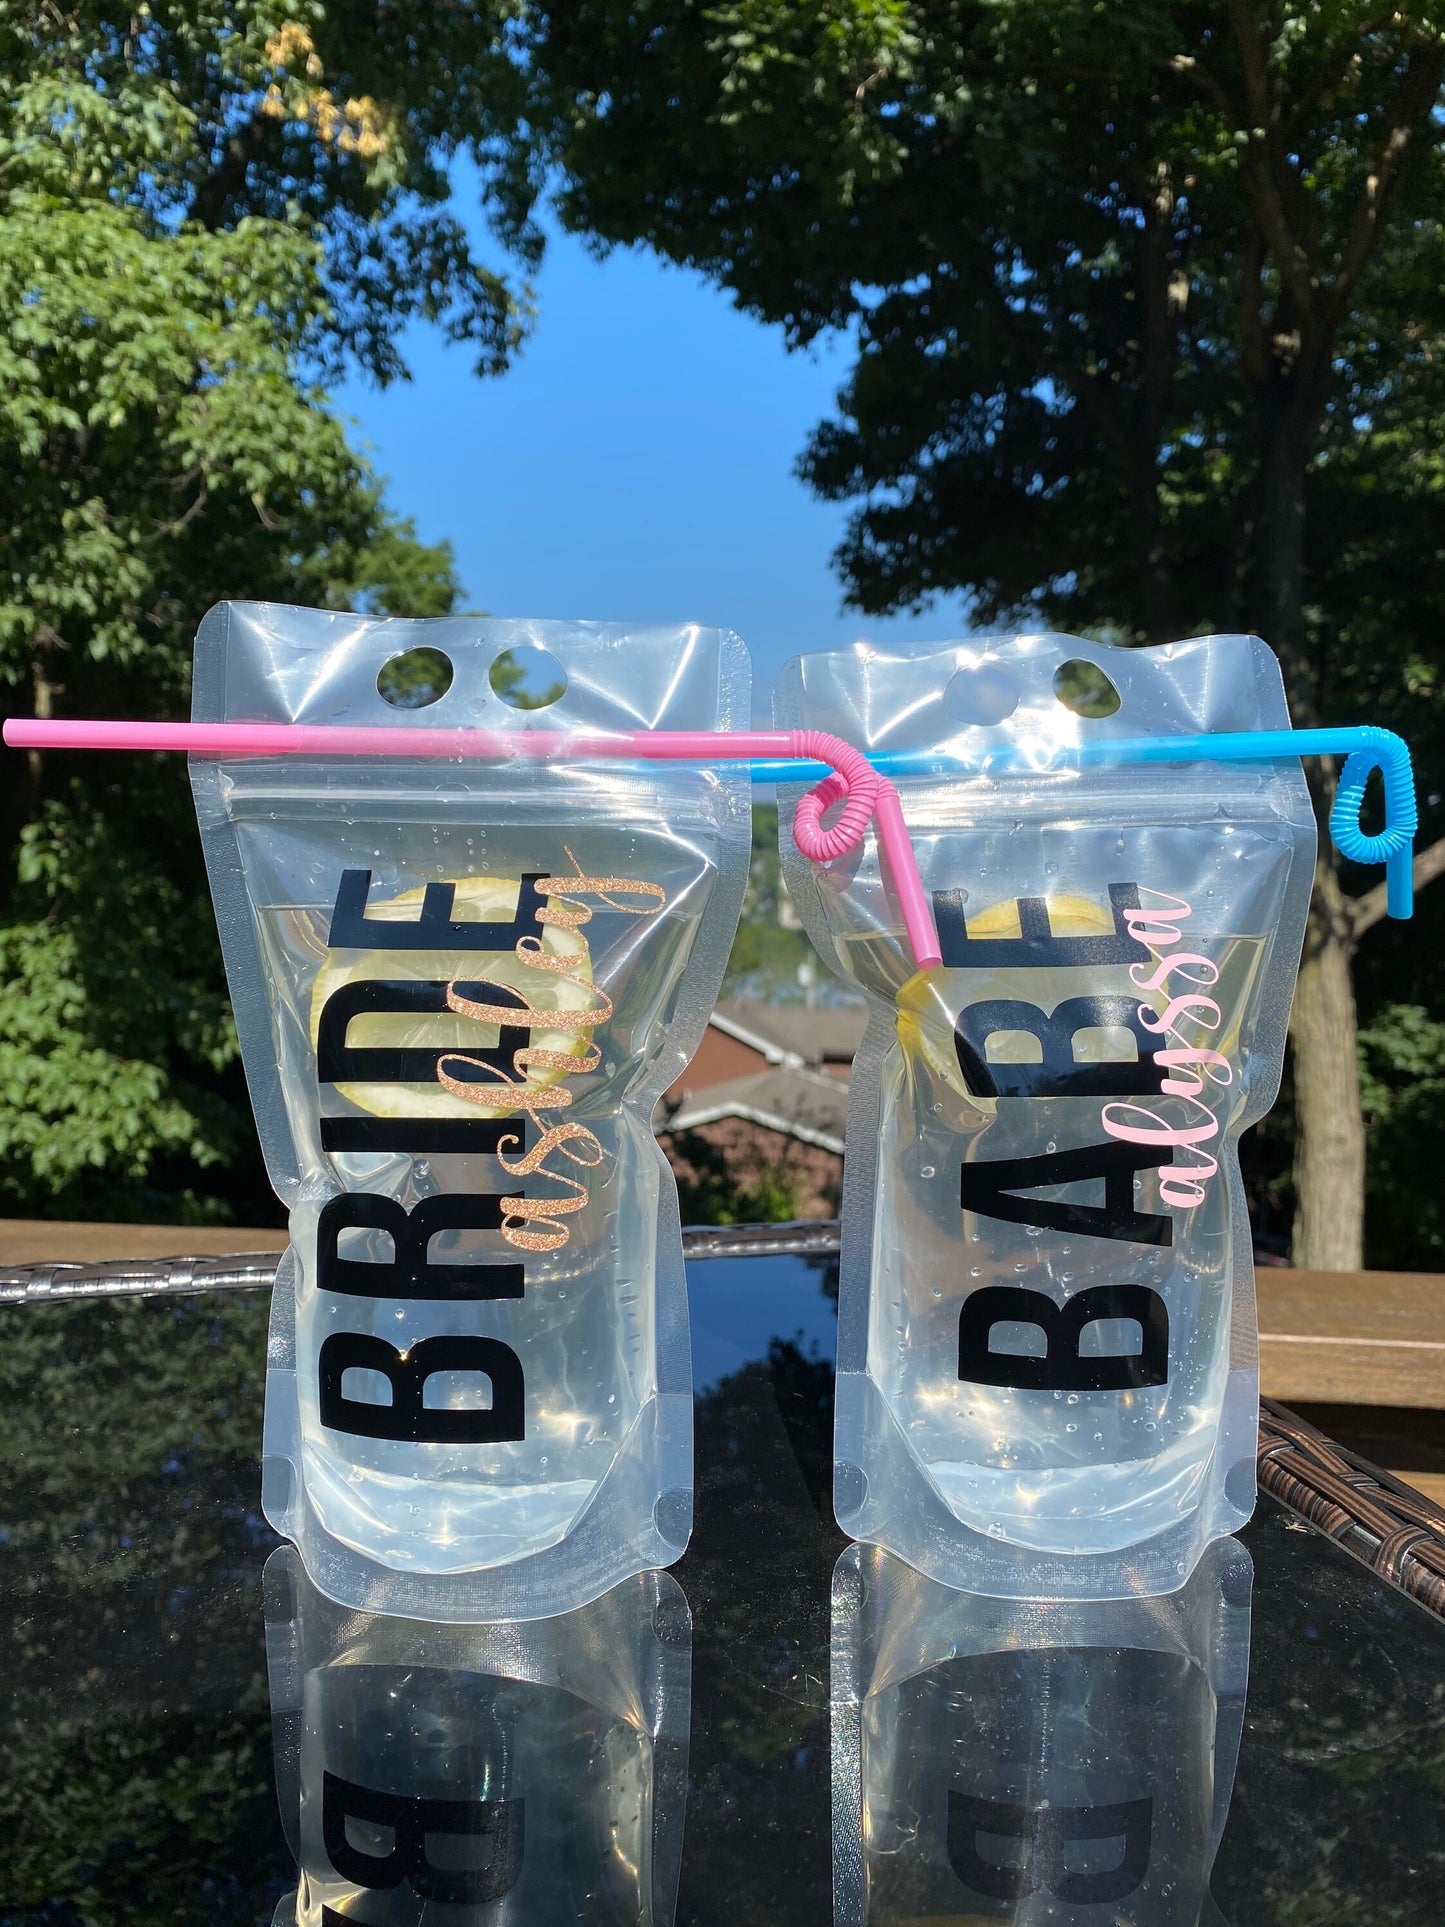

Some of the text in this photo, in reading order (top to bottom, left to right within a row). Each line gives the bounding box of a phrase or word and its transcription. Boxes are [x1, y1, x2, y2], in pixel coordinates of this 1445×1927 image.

[317, 868, 551, 1444] BRIDE
[436, 844, 666, 1251] ashley
[932, 882, 1173, 1391] BABE
[1102, 885, 1233, 1208] alyssa
